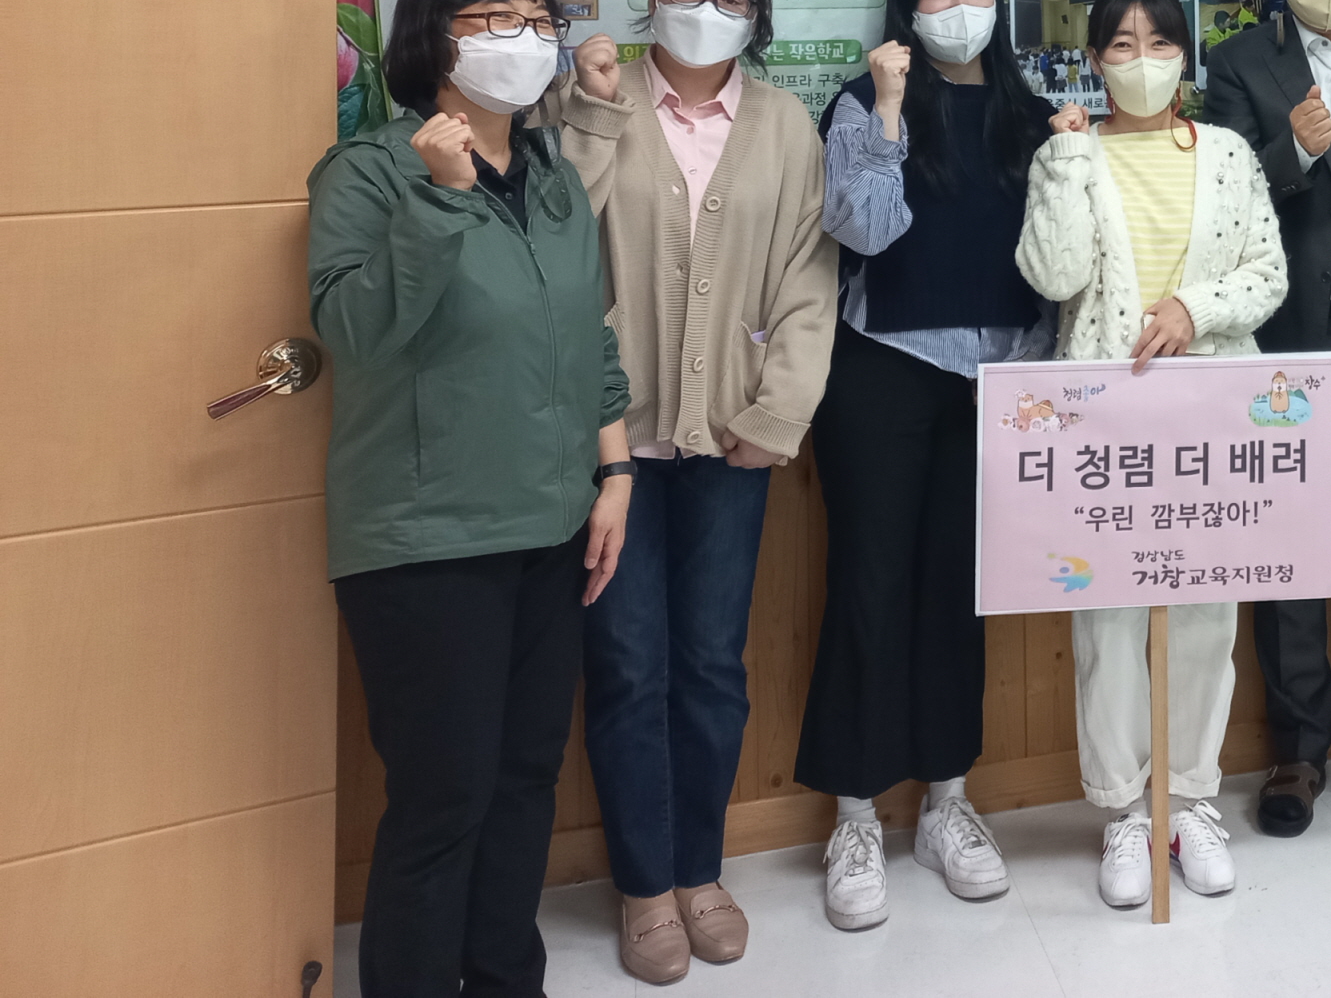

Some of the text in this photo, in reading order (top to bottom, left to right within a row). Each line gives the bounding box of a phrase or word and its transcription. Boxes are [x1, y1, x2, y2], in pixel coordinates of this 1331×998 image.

[789, 42, 844, 61] 작은학교
[771, 74, 812, 88] 인프라
[1082, 98, 1109, 109] 새로
[1018, 438, 1307, 492] 더 청렴 더 배려
[1073, 504, 1134, 533] “우린
[1131, 549, 1186, 564] 경상남도
[1131, 564, 1295, 589] 거창교육지원청
